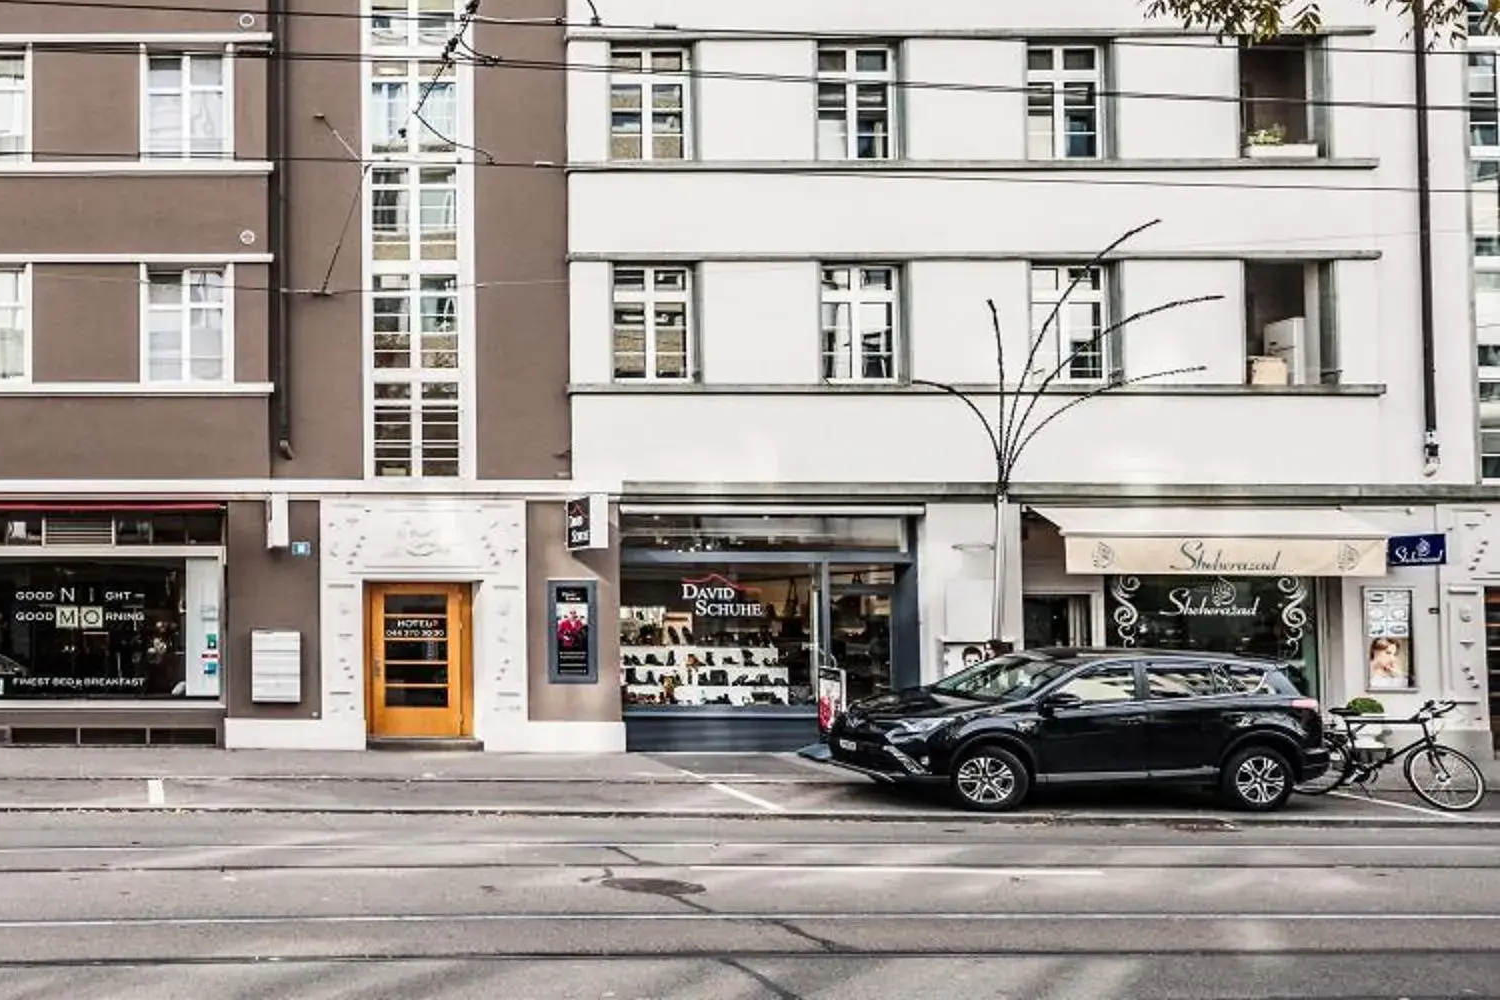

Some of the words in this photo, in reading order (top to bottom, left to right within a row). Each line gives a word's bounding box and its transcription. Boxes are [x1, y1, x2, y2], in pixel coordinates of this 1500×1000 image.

[15, 591, 55, 601] GOOD
[681, 583, 736, 600] DAVID
[695, 599, 763, 617] SCHUHE
[15, 611, 55, 621] GOOD
